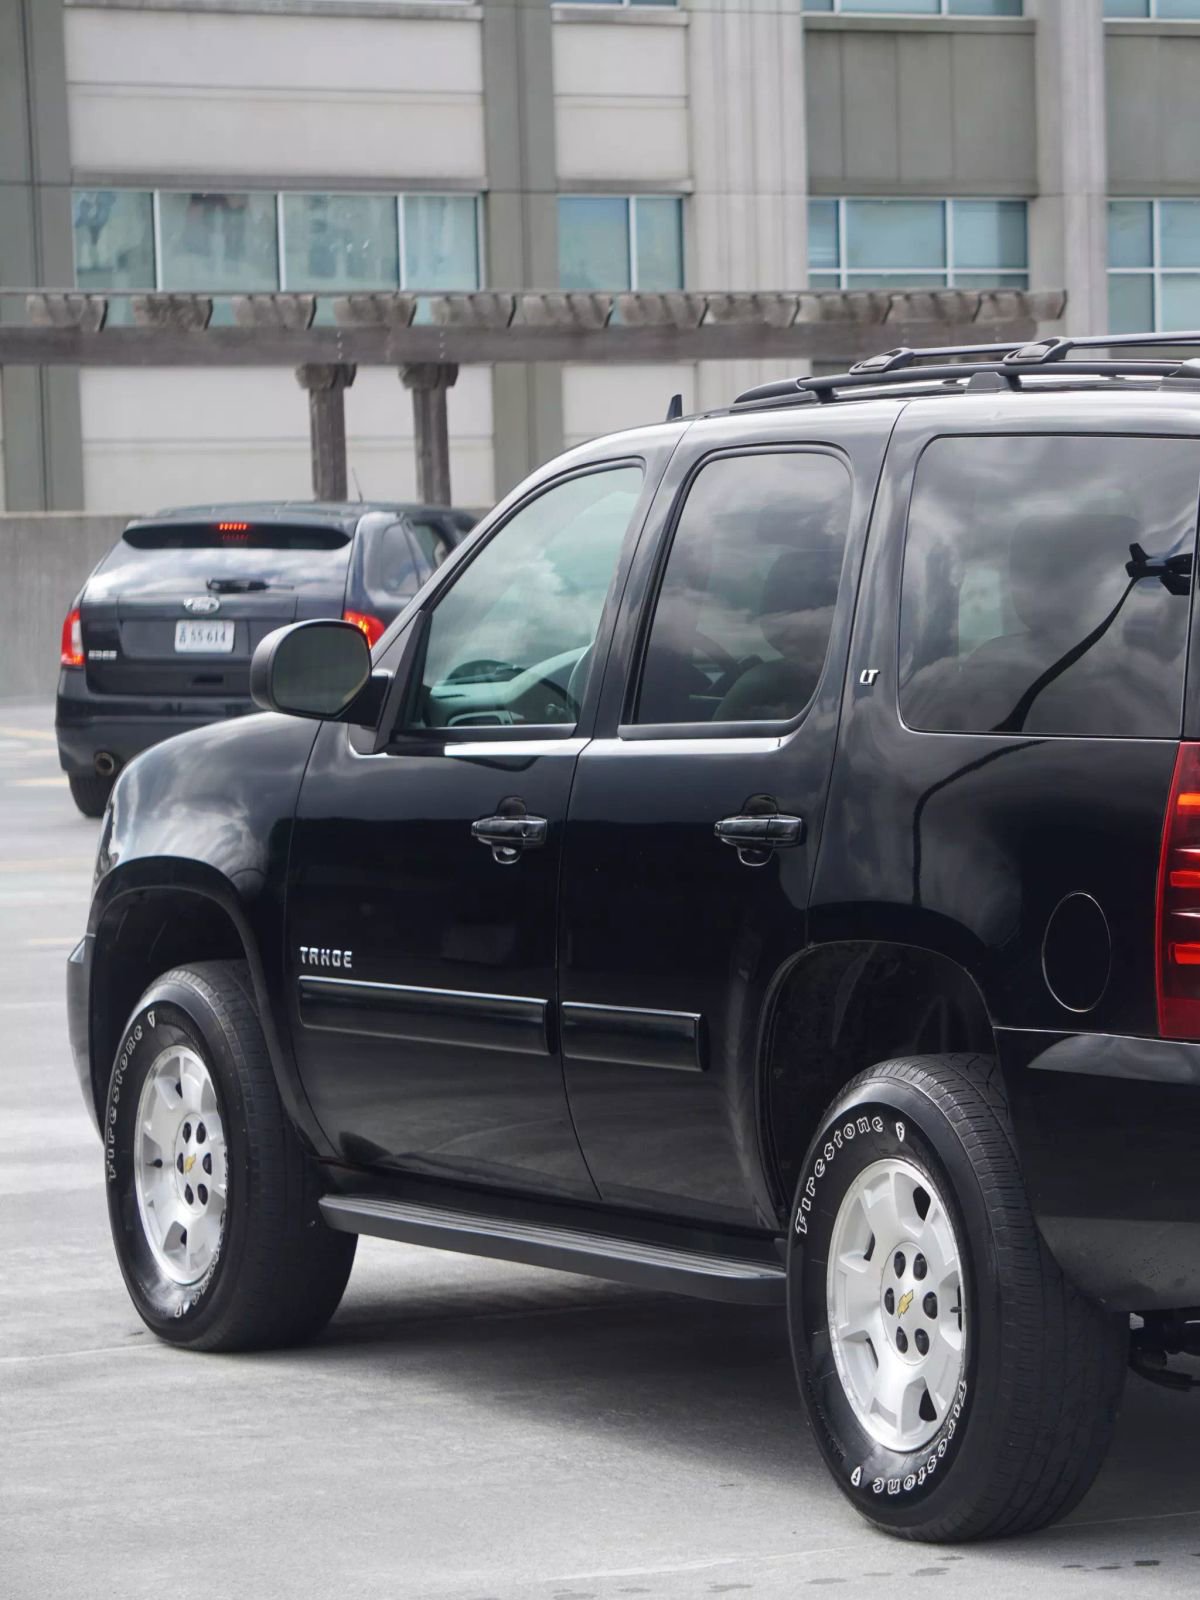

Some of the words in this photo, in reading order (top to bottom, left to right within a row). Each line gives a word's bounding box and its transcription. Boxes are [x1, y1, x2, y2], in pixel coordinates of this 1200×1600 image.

[860, 669, 880, 685] LT
[299, 946, 353, 968] TAHOE
[794, 1116, 884, 1234] Firestone
